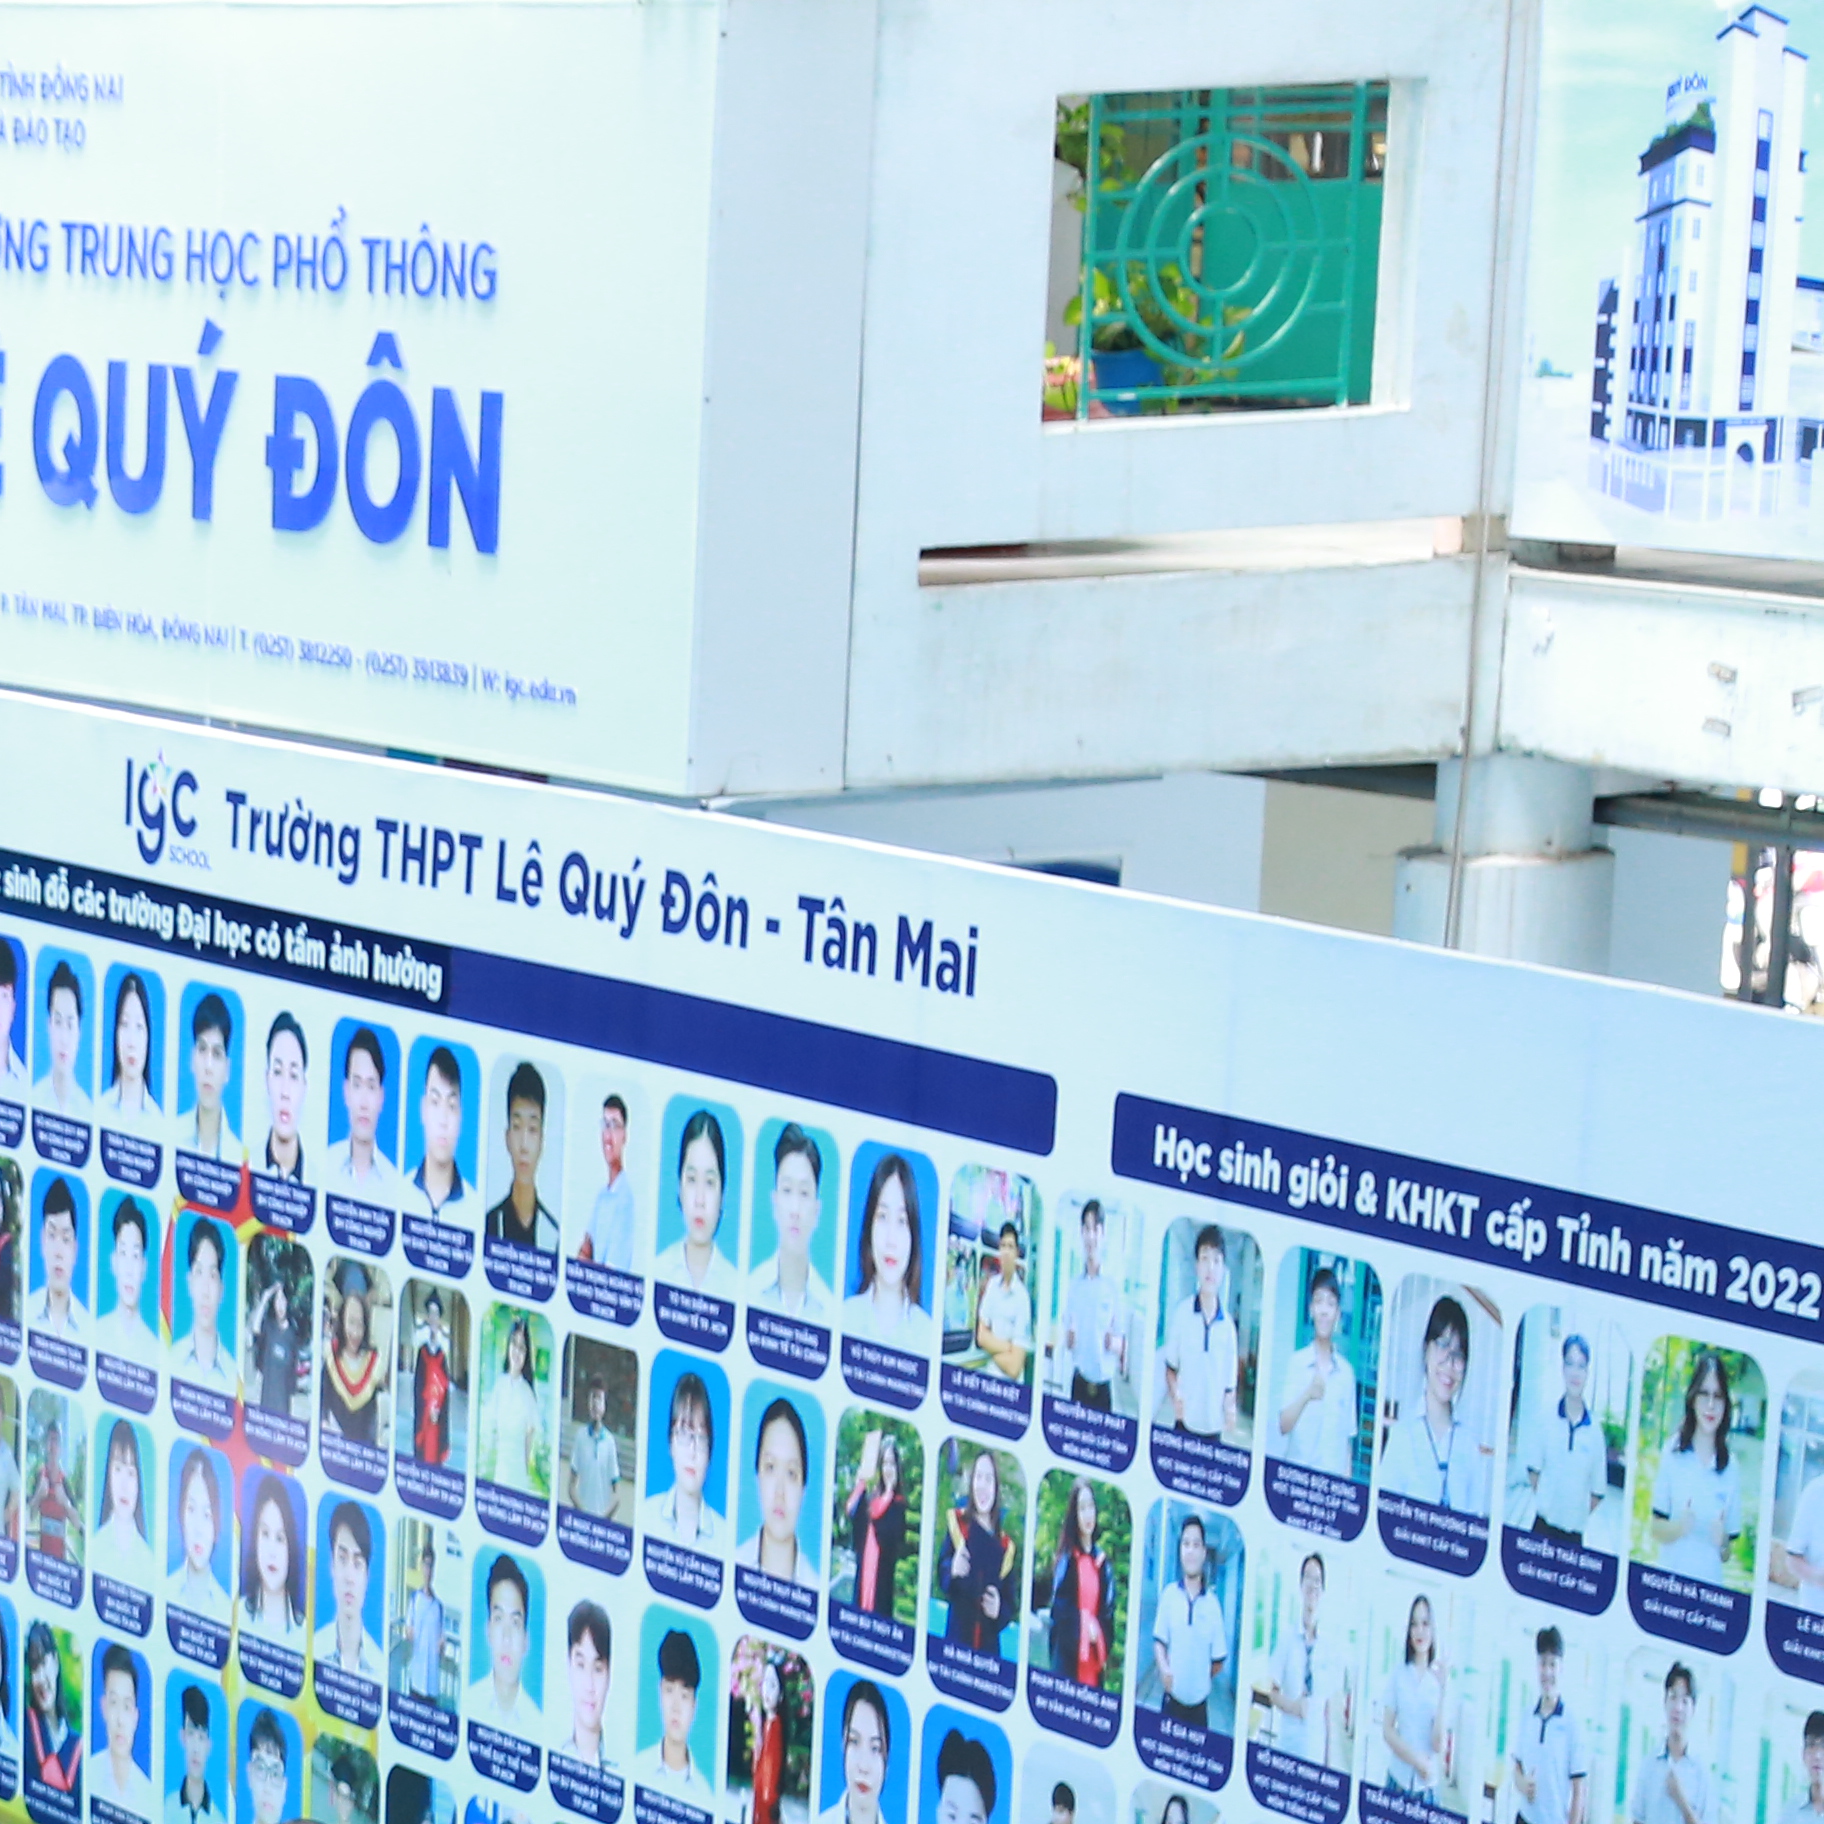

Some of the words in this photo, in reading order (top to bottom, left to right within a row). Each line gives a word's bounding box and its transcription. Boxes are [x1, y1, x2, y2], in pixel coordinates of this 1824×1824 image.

[61, 221, 174, 283] TRUNG
[185, 228, 261, 300] HỌC
[273, 205, 348, 294] PHỔ
[361, 221, 499, 302] THÔNG
[32, 318, 239, 522] QUÝ
[266, 331, 504, 555] ĐÔN
[3, 864, 41, 904] sinh
[44, 867, 69, 910] đỗ
[72, 880, 105, 918] các
[109, 888, 174, 940] trường
[177, 903, 211, 950] Đại
[214, 910, 251, 958] học
[255, 921, 281, 959] có
[285, 922, 325, 969] tầm
[329, 930, 368, 978] ảnh
[373, 944, 442, 1001] hưởng
[169, 846, 212, 871] SCHOOL
[226, 789, 360, 886] Trường
[376, 817, 483, 898] THPT
[497, 837, 543, 907] Lê
[559, 856, 645, 940] Quý
[662, 868, 749, 949] Đôn
[799, 894, 876, 976] Tân
[895, 914, 979, 999] Mai
[1154, 1121, 1210, 1184] Học
[1219, 1139, 1282, 1195] sinh
[1288, 1152, 1349, 1216] giỏi
[1355, 1179, 1378, 1216] &
[1388, 1178, 1480, 1240] KHKT
[1485, 1198, 1548, 1265] cấp
[1557, 1209, 1631, 1277] Tỉnh
[1641, 1237, 1718, 1298] năm
[1724, 1254, 1822, 1323] 2022
